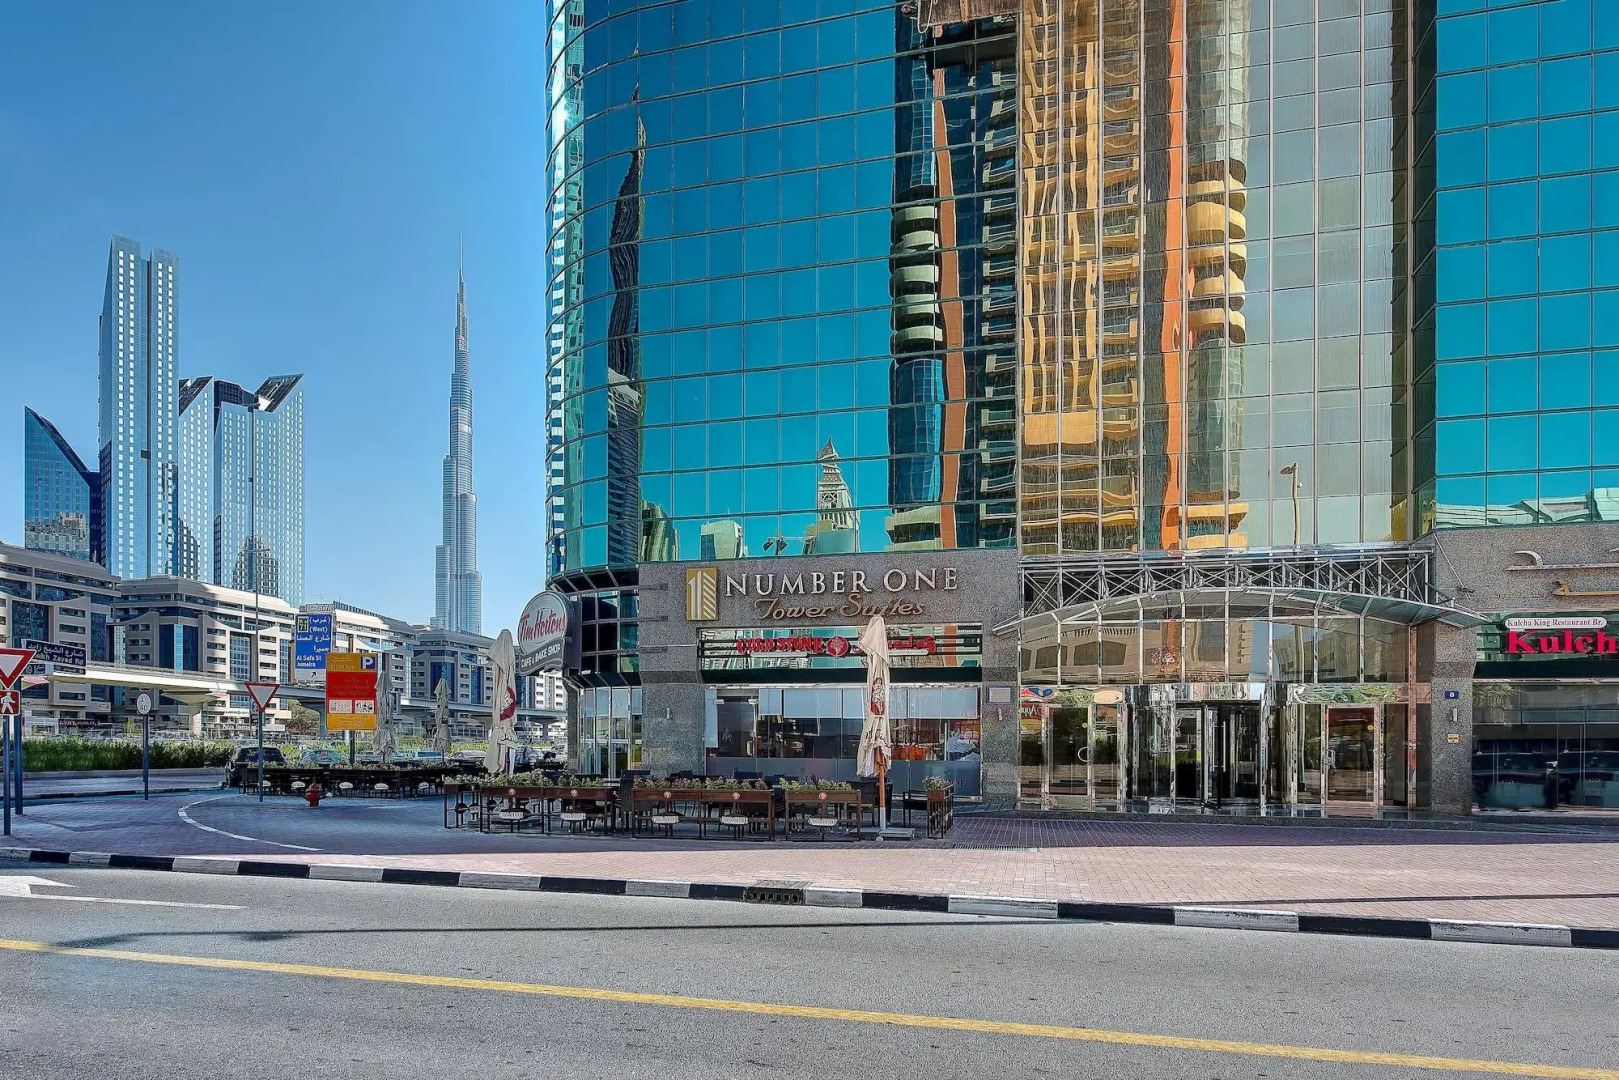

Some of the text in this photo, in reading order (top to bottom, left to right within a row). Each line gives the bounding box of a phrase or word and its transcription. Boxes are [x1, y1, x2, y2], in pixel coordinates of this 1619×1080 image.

[726, 568, 958, 597] NUMBER ONE
[754, 593, 925, 620] Tower Suites
[299, 623, 307, 631] 71
[520, 613, 534, 641] Tim
[1507, 618, 1603, 627] Kulcha King Restaurant Br.
[27, 643, 84, 658] شارع الشيخ زايد
[737, 636, 824, 654] COLD STONE
[52, 655, 73, 664] Zayed
[362, 656, 374, 669] P
[520, 657, 532, 668] CAFE
[535, 649, 548, 661] BAKE
[548, 643, 561, 656] SHOP
